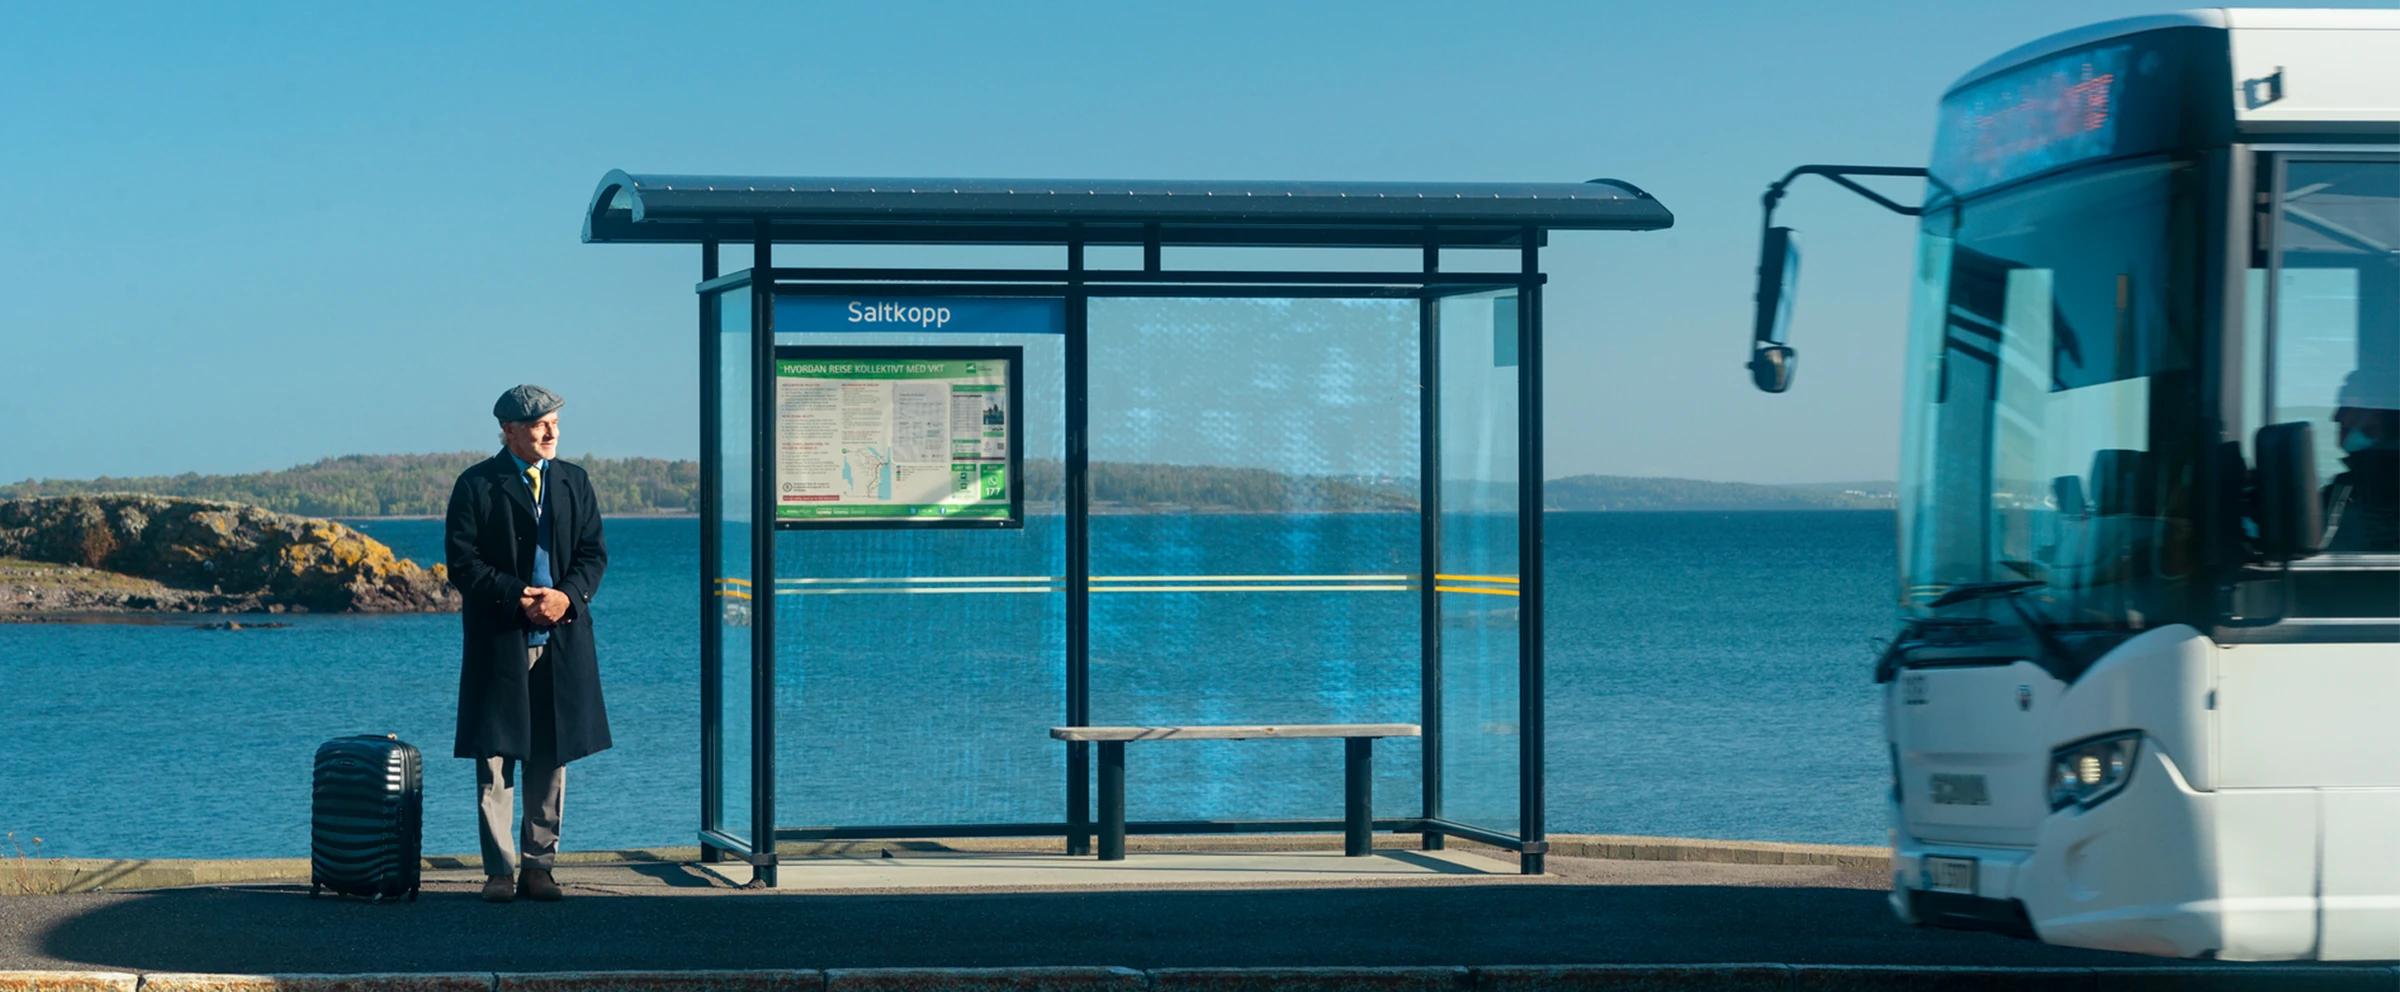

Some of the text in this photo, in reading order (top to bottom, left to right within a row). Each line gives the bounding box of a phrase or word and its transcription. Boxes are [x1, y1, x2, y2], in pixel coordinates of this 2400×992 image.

[848, 301, 951, 328] Saltkopp
[783, 364, 944, 374] HVORDAN REISE KOLLEKTIVT MED VKT
[986, 487, 1001, 496] 177
